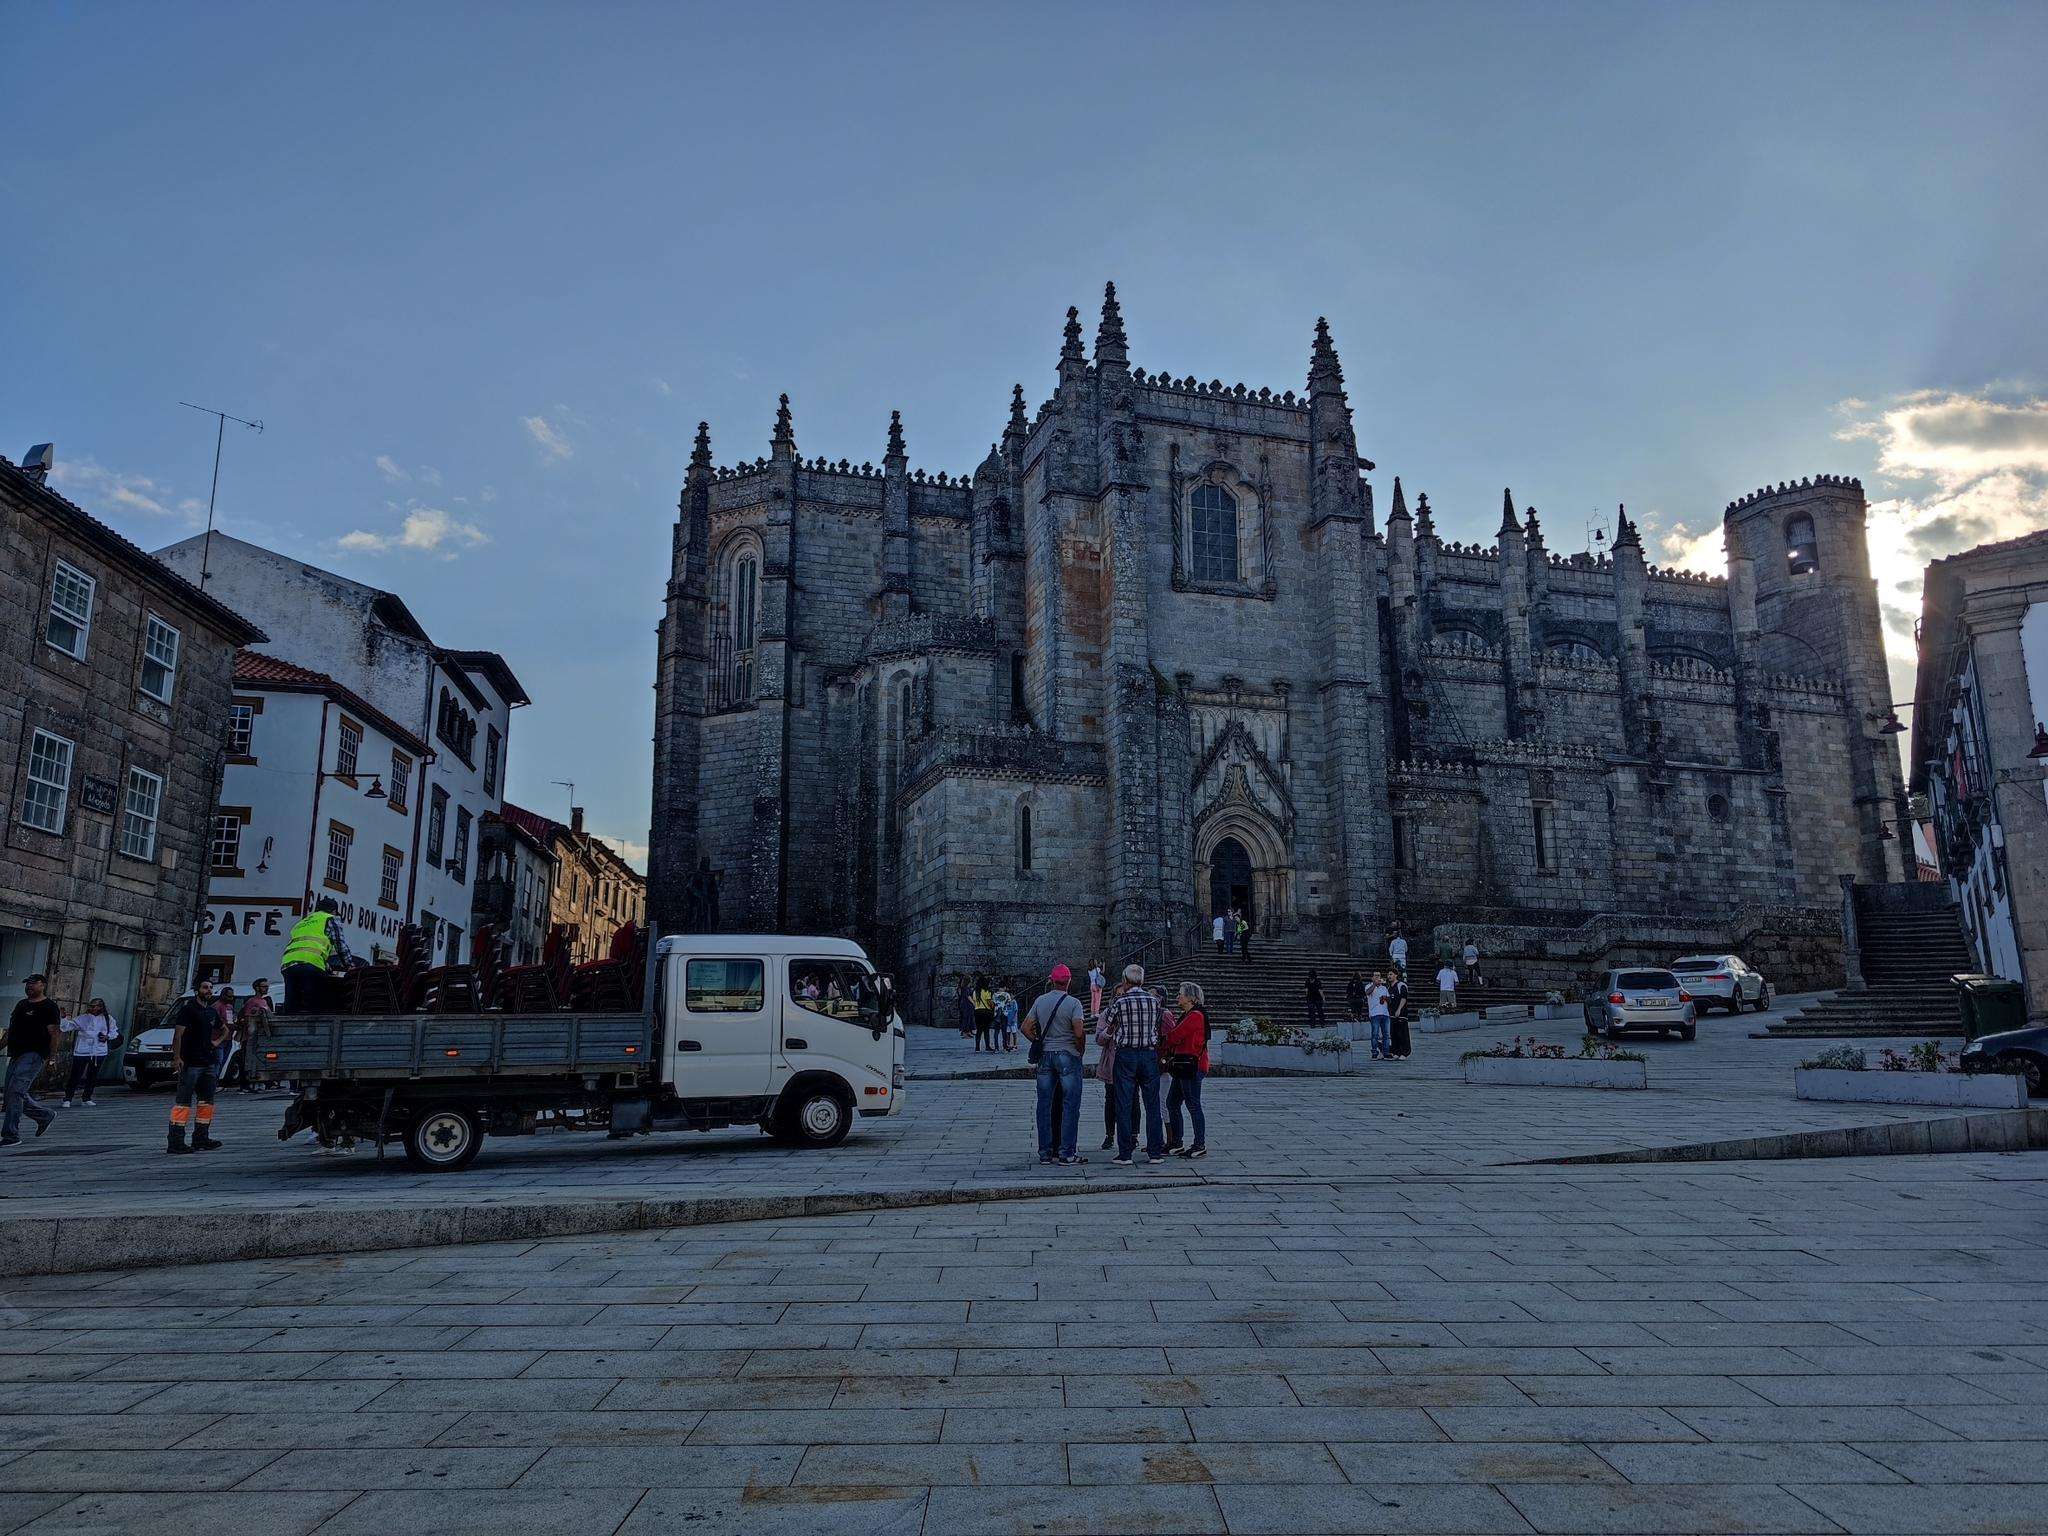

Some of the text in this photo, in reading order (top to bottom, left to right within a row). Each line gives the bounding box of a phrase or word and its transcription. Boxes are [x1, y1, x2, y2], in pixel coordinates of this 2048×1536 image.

[202, 909, 282, 935] CAFÉ
[341, 901, 353, 925] DO
[358, 907, 377, 933] BOM
